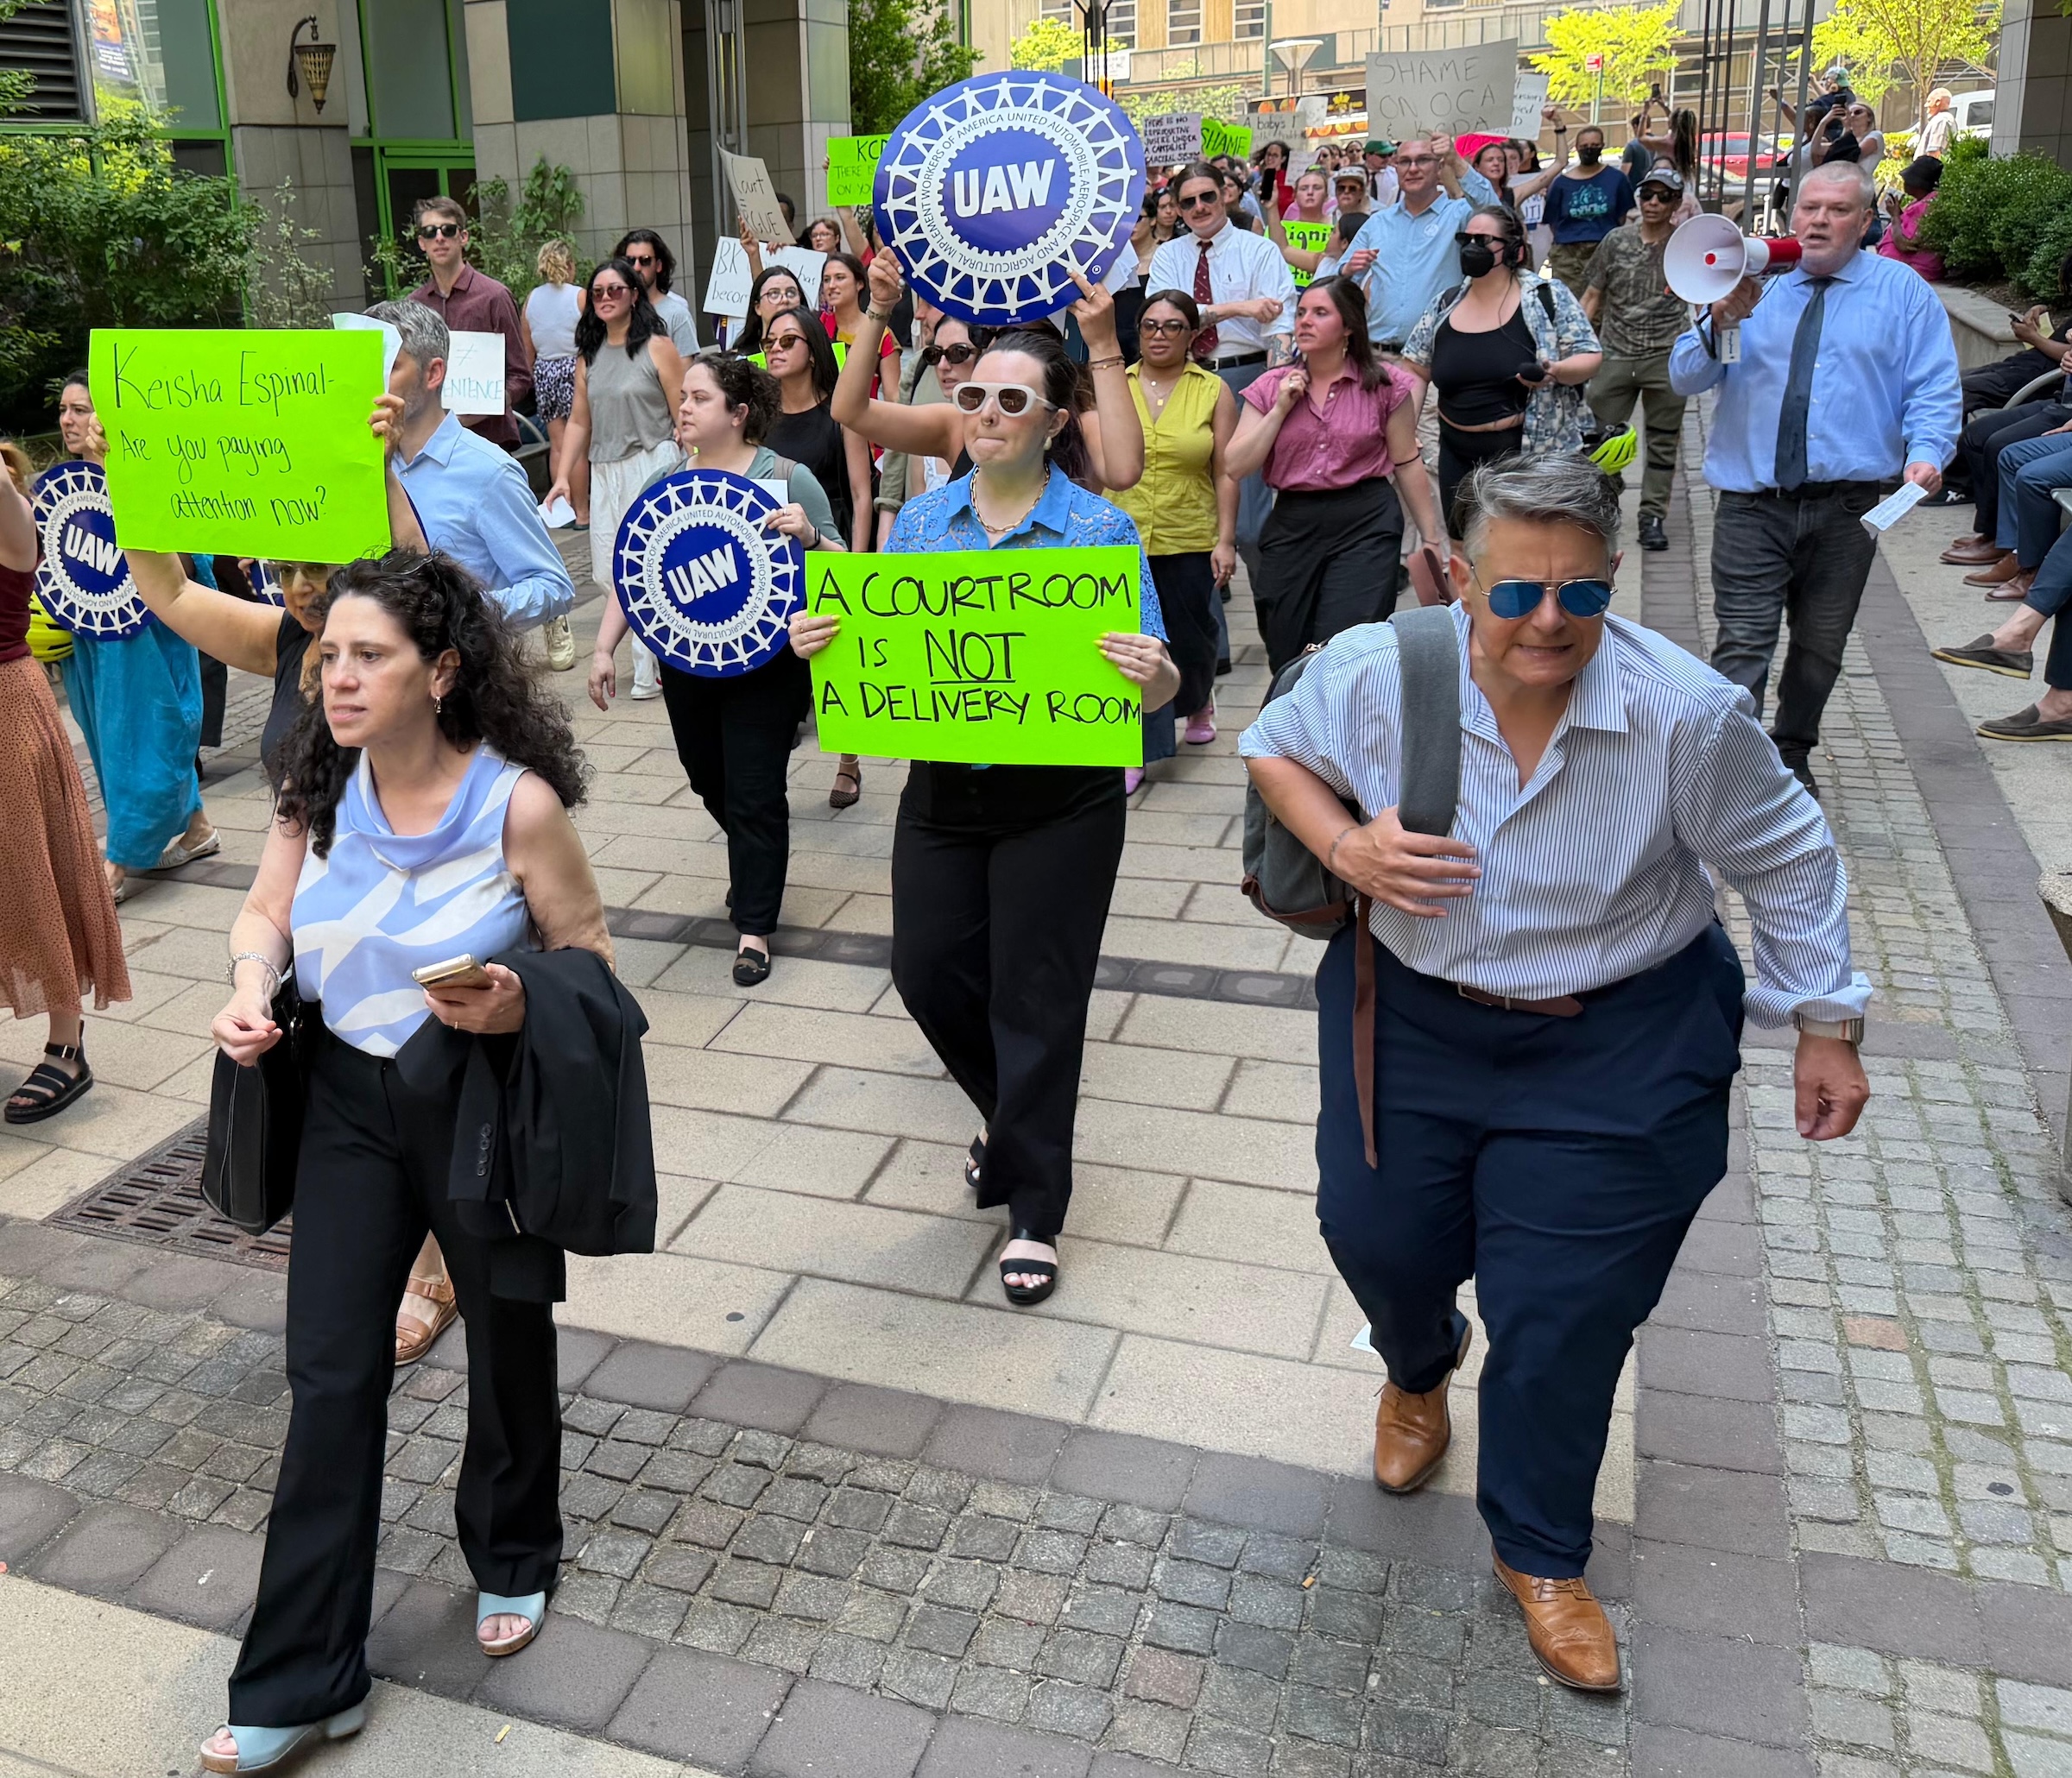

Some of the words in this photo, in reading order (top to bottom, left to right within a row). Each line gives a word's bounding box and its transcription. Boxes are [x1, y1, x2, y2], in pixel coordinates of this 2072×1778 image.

[1374, 54, 1480, 85] SHAME
[1008, 113, 1047, 125] UNITED
[1379, 94, 1418, 120] ON
[1430, 84, 1495, 117] OCA
[942, 136, 955, 149] OF
[957, 114, 1004, 138] AMERICA
[1201, 128, 1248, 155] SHAME
[1047, 122, 1090, 177] AUTOMOBILE,
[833, 164, 861, 180] THERE
[837, 184, 851, 196] ON
[857, 183, 871, 196] YO
[921, 148, 944, 200] WORKERS
[953, 158, 1056, 218] UAW
[1058, 180, 1090, 240] AEROSPACE
[921, 202, 957, 258] IMPLEMENT
[716, 240, 742, 275] BK
[958, 253, 1034, 273] AGRICULTURAL
[1037, 237, 1059, 259] AND
[113, 343, 222, 411] Keisha
[120, 430, 151, 461] Are
[167, 432, 206, 484] you
[220, 434, 292, 476] paying
[170, 489, 257, 520] attention
[270, 485, 326, 526] now?
[683, 509, 714, 521] UNITED
[654, 516, 683, 545] AMERICA
[65, 523, 123, 576] UAW
[649, 544, 657, 557] OF
[647, 558, 658, 598] WORKERS
[666, 543, 738, 604] UAW
[755, 553, 767, 603] AEROSPACE
[814, 567, 852, 616] A
[862, 571, 1132, 617] COURTROOM
[654, 599, 692, 634] IMPLEMENT
[693, 618, 747, 639] AGRICULTURAL
[746, 602, 759, 621] AND
[858, 636, 888, 668] IS
[925, 629, 1027, 683] NOT
[821, 680, 850, 716] A
[859, 681, 1031, 725] DELIVERY
[1045, 690, 1141, 727] ROOM
